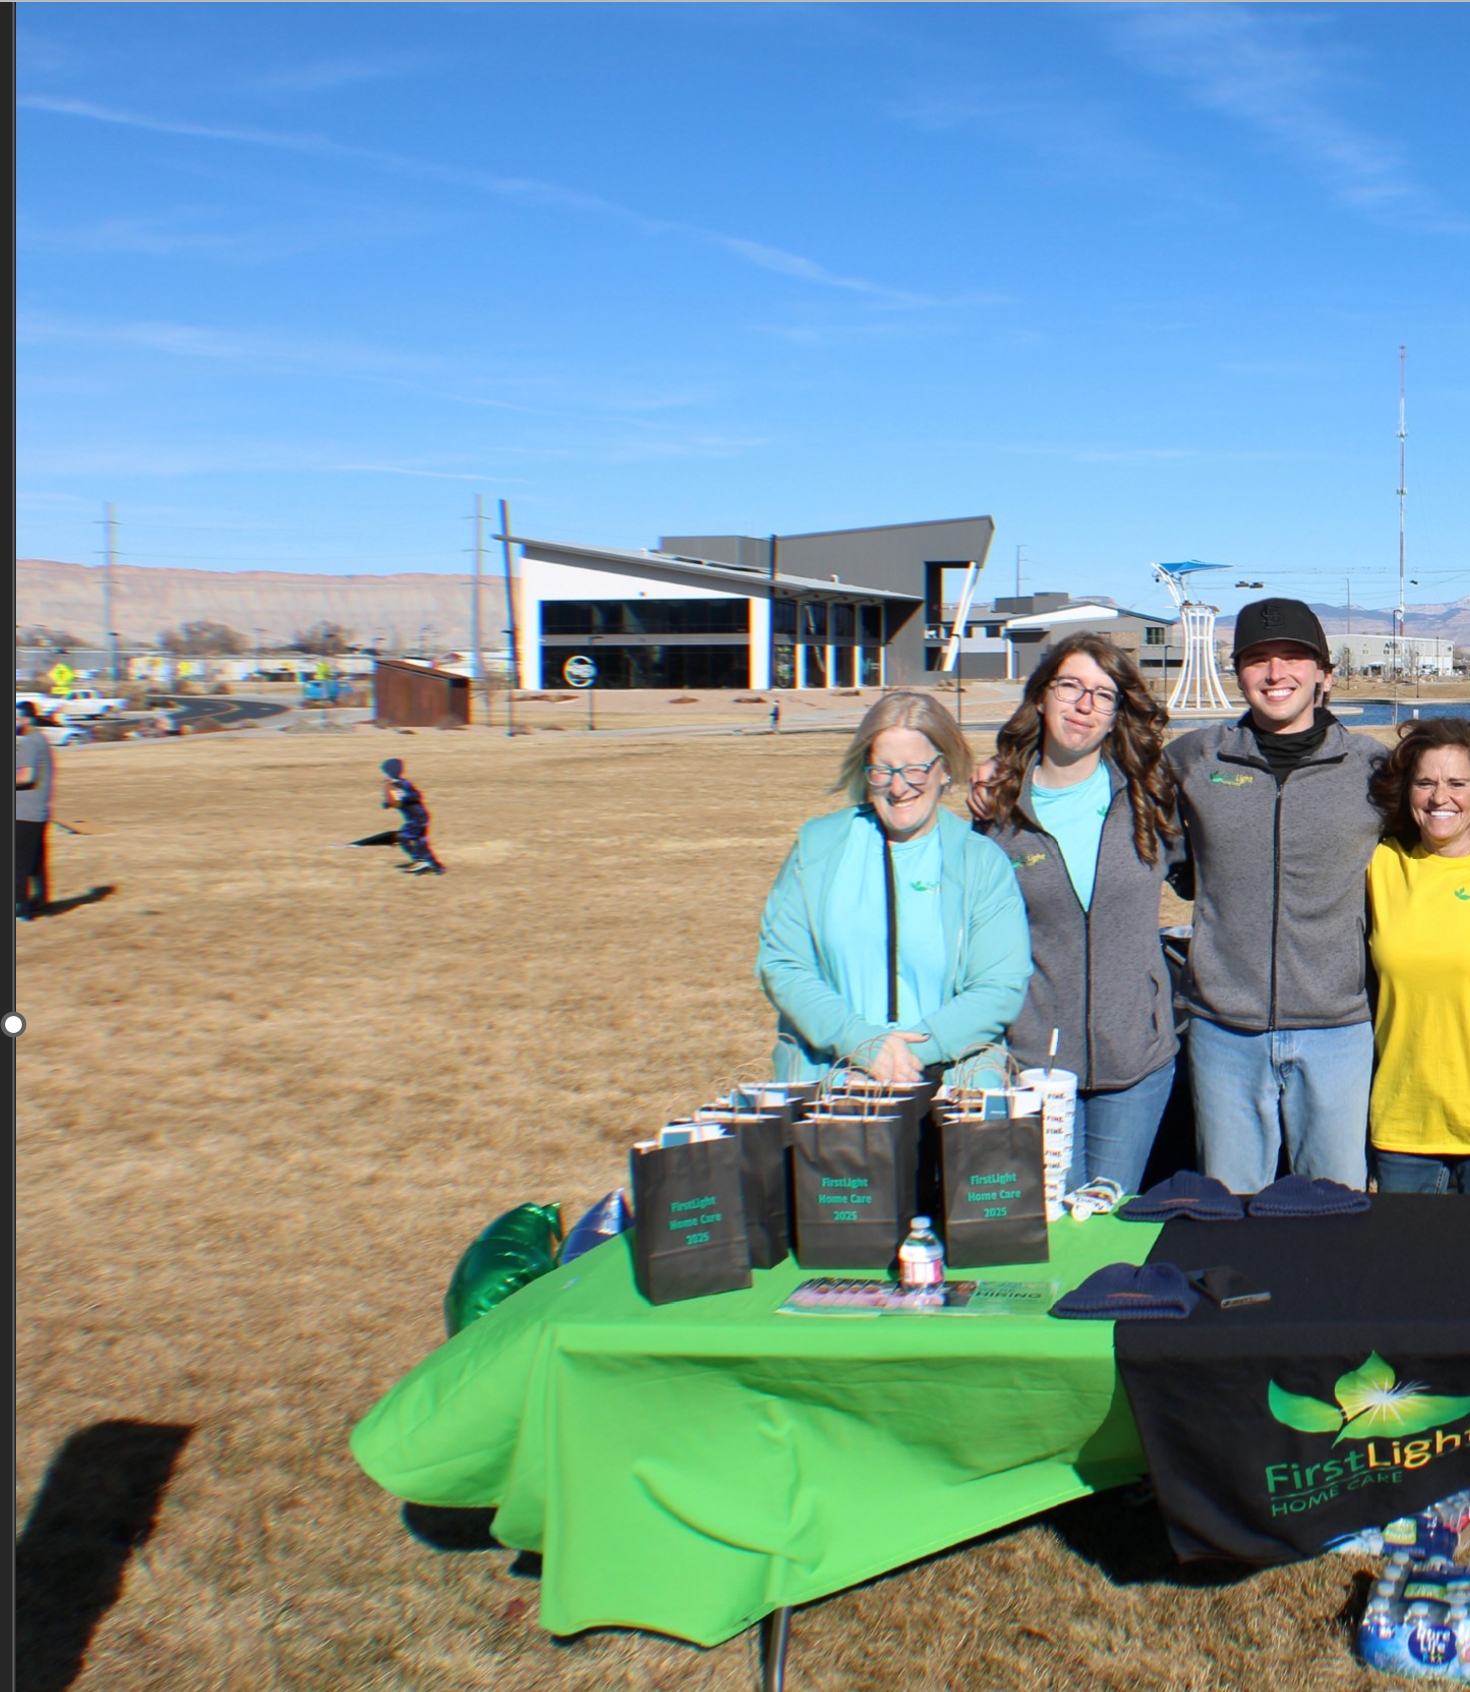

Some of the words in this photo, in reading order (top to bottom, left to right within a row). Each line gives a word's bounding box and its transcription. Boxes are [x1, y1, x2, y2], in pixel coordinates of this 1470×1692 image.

[821, 1177, 869, 1189] FirstLight
[970, 1172, 1018, 1185] FirstLight
[818, 1194, 848, 1204] Home
[849, 1194, 872, 1204] Care
[967, 1191, 997, 1202] Home
[999, 1190, 1021, 1199] Care
[833, 1211, 857, 1221] 2025
[983, 1207, 1007, 1218] 2025
[669, 1217, 698, 1230] Home
[700, 1212, 722, 1224] Care
[686, 1232, 710, 1245] 2025
[976, 1291, 1042, 1299] HIRING
[1271, 1485, 1339, 1517] HOME
[1347, 1470, 1403, 1491] CARE
